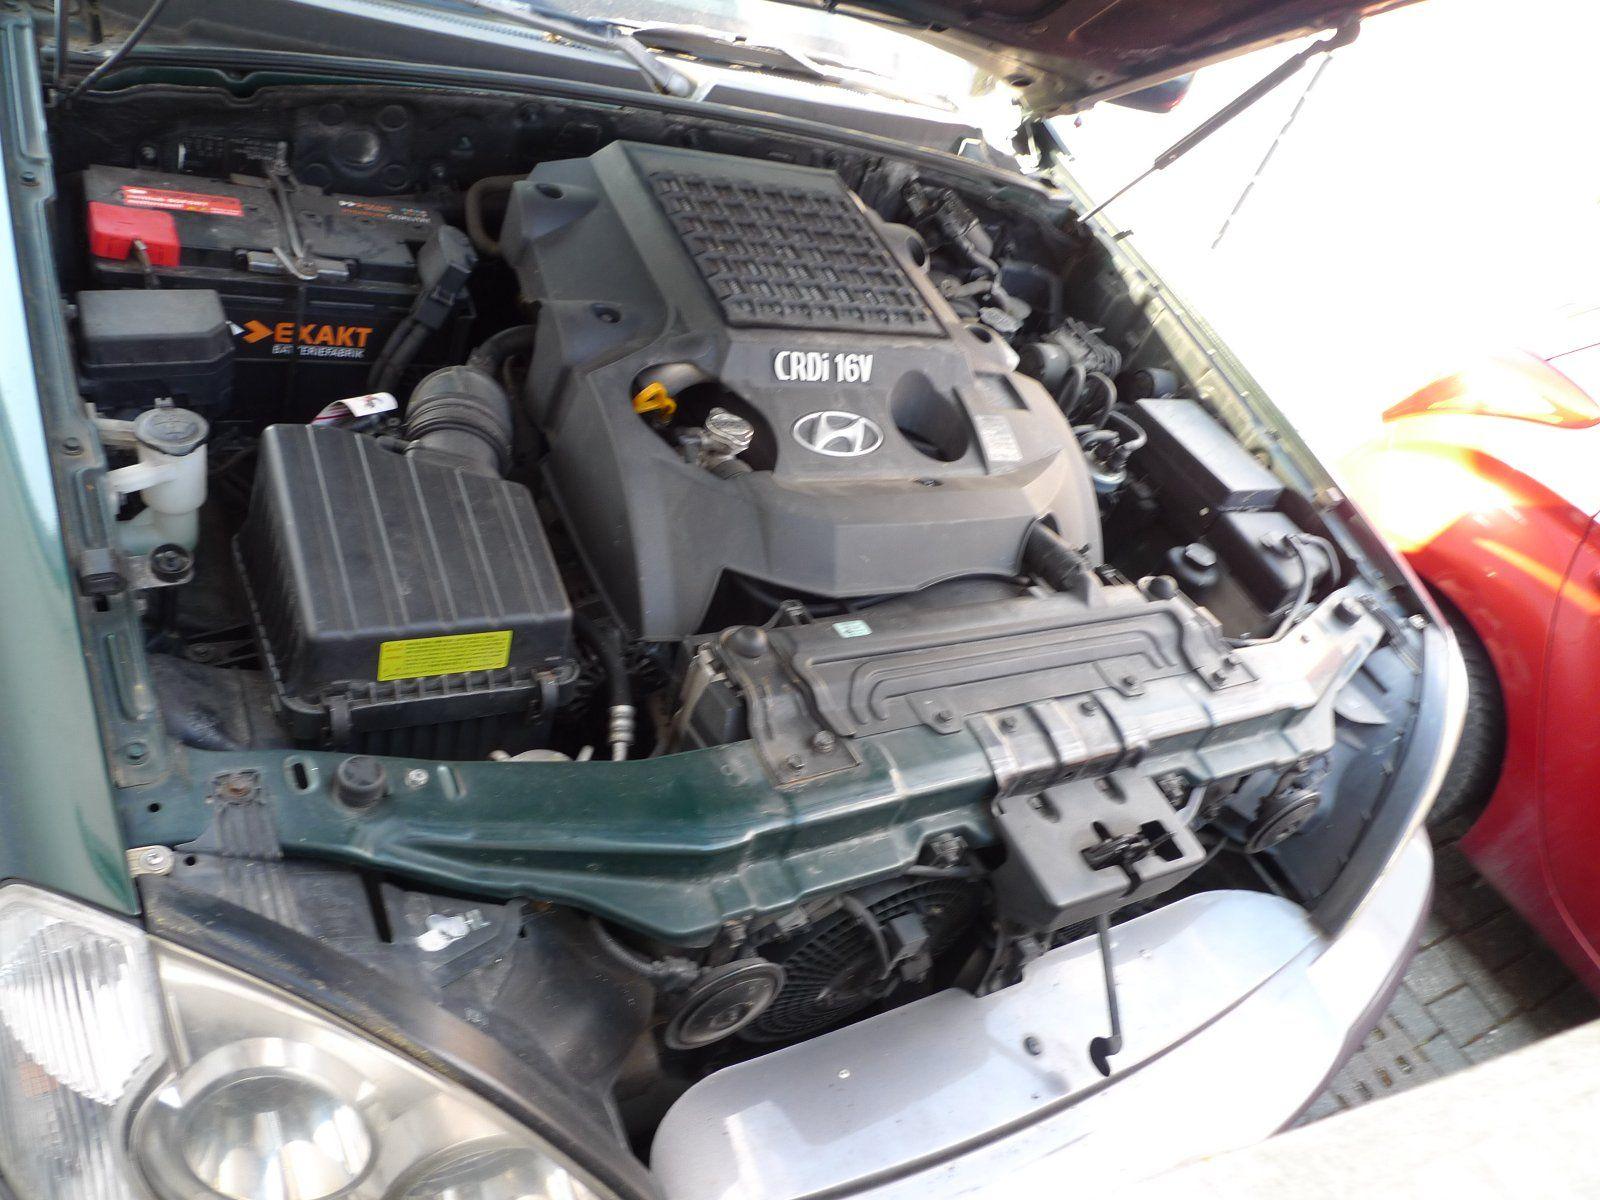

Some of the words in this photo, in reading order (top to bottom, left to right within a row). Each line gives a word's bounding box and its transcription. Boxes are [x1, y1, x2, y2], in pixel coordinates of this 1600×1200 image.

[275, 322, 373, 347] EXAKT
[774, 350, 829, 382] CRDi
[834, 353, 872, 383] 16V
